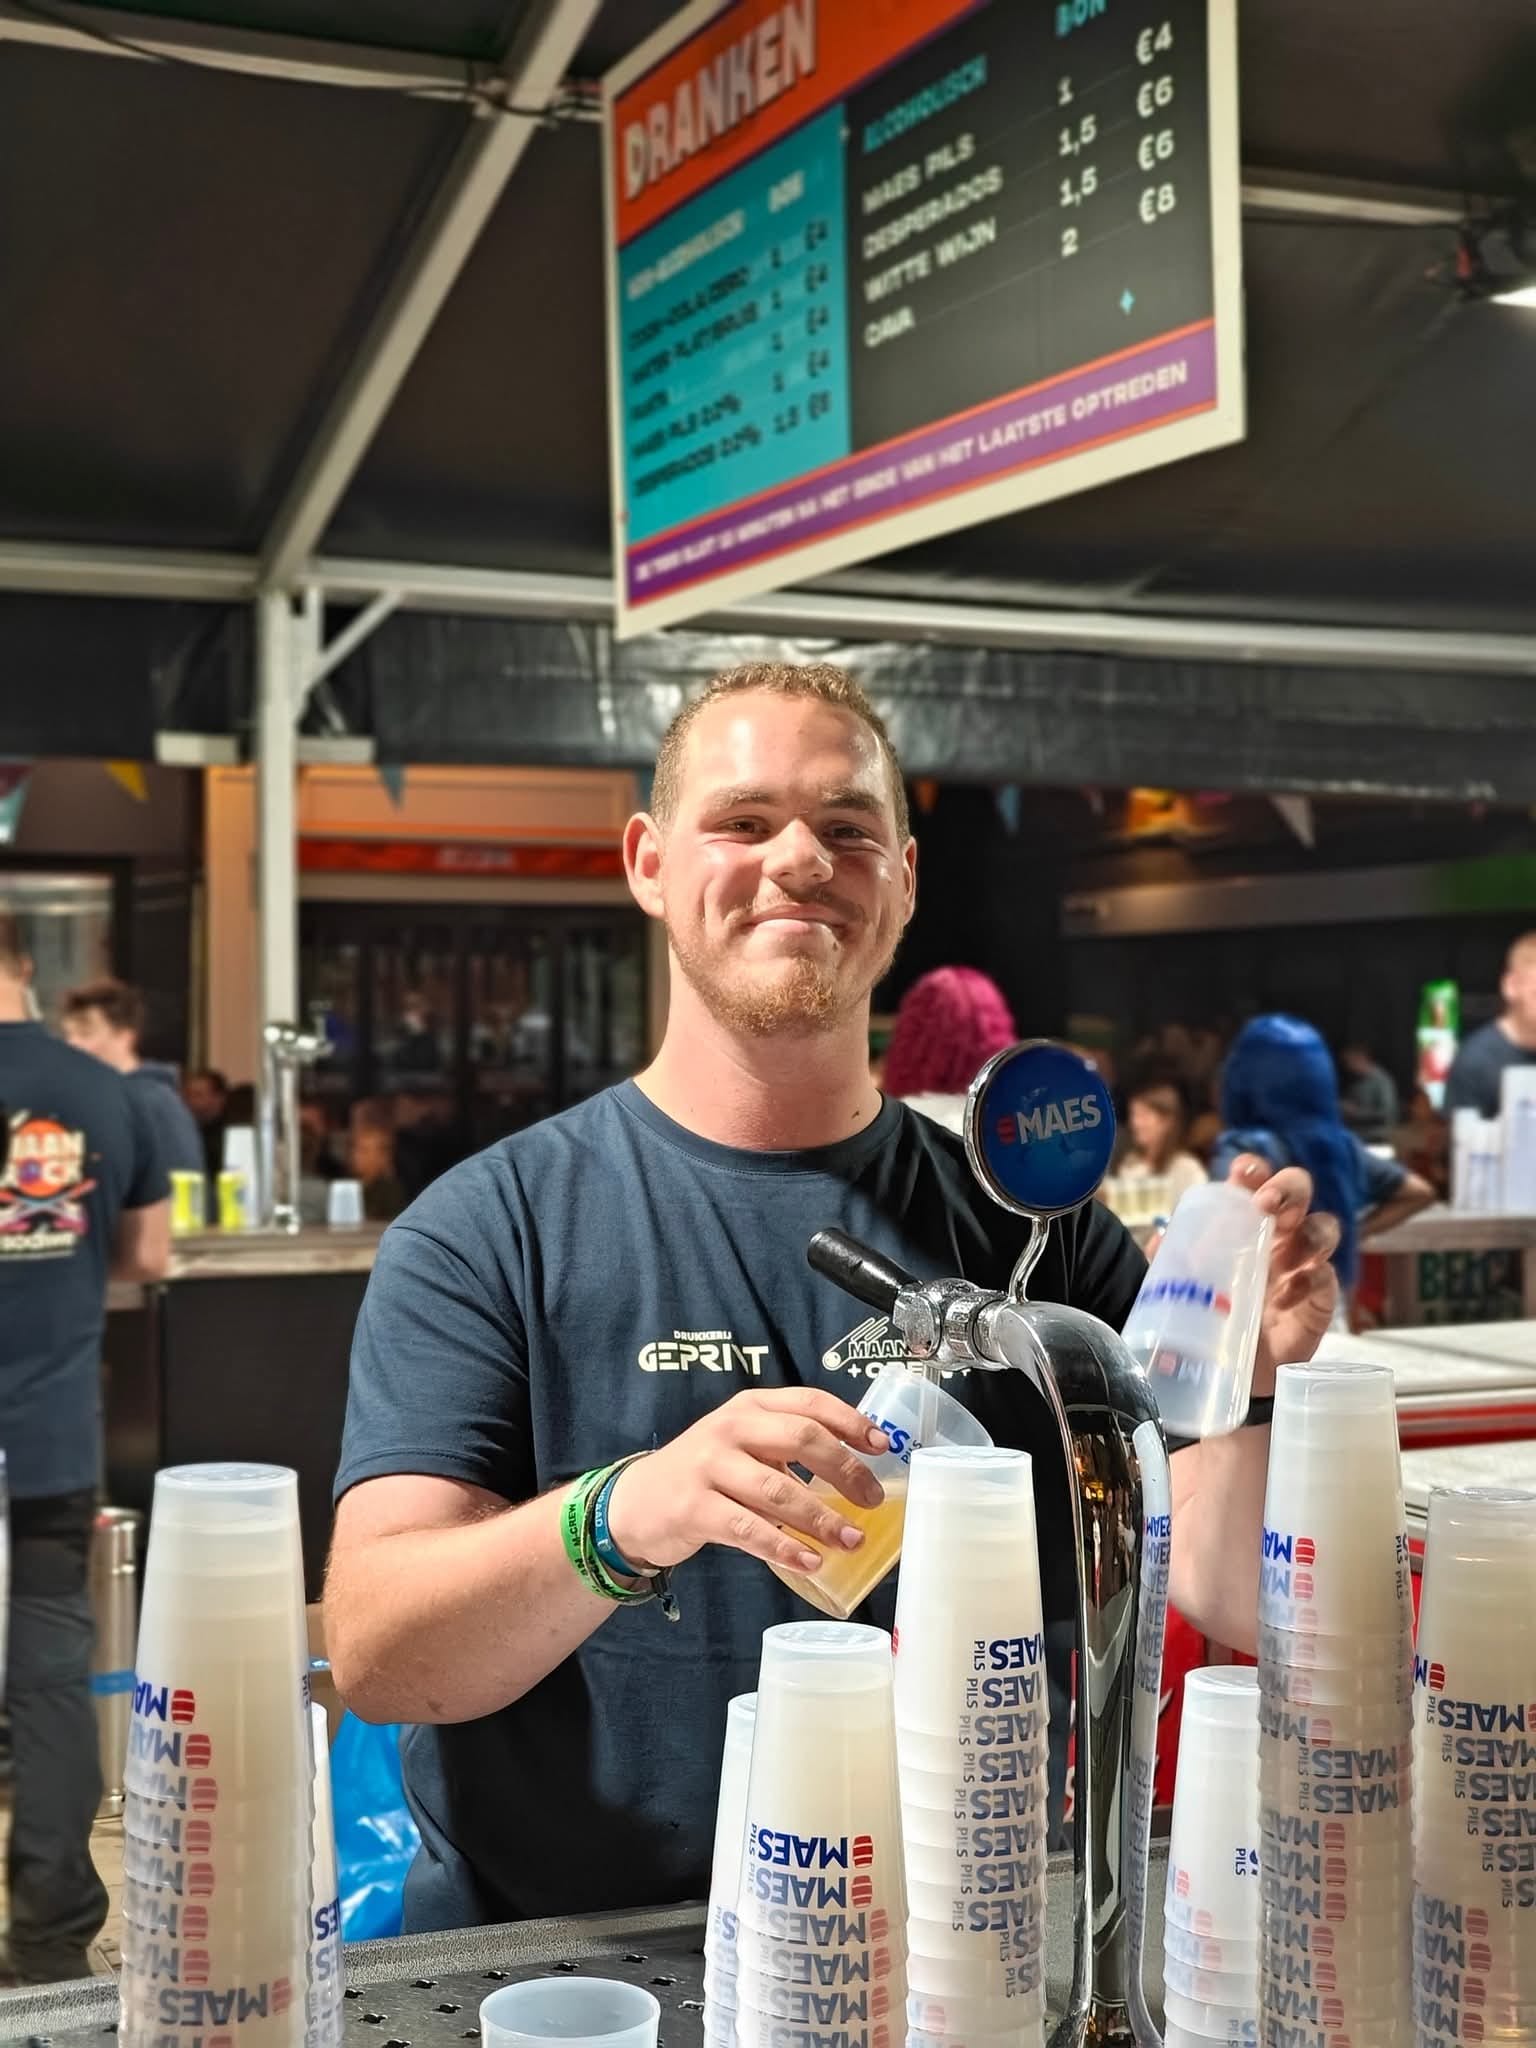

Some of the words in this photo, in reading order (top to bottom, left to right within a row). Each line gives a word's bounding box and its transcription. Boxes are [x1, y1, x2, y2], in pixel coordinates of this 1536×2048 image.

[624, 0, 815, 198] DRANKEN
[863, 165, 920, 214] MAES
[925, 133, 974, 179] PILS
[1059, 77, 1073, 105] 1
[1136, 22, 1171, 64] €4
[863, 166, 1002, 259] DESPERADOS
[1059, 115, 1096, 155] 1,5
[1137, 76, 1172, 117] €6
[864, 252, 931, 302] WITTE
[935, 217, 996, 266] WIJN
[1060, 167, 1097, 206] 1,5
[1138, 130, 1173, 170] €6
[864, 307, 914, 347] CAVA
[1061, 228, 1078, 256] 2
[1139, 184, 1175, 223] €8
[979, 404, 1067, 455] LAATSTE
[1072, 360, 1188, 421] OPTREDEN
[1017, 1095, 1101, 1145] MAES
[673, 1330, 732, 1341] DRUKKERIJ
[848, 1339, 911, 1359] MAAN
[1262, 1528, 1292, 1564] MA
[974, 1640, 985, 1671] PILS
[132, 1682, 169, 1722] MA
[967, 1678, 978, 1708] PILS
[959, 1715, 971, 1745] PILS
[1426, 1695, 1436, 1723] PILS
[1438, 1699, 1525, 1732] MAES
[1312, 1746, 1398, 1779] MAES
[1442, 1734, 1452, 1762] PILS
[964, 1752, 975, 1783] PILS
[1313, 1781, 1399, 1814] MAES
[1455, 1770, 1466, 1799] PILS
[1469, 1773, 1536, 1802] AES
[954, 1789, 966, 1820] PILS
[1467, 1806, 1479, 1836] PILS
[1482, 1807, 1536, 1837] AES
[758, 1829, 848, 1869] MAES
[957, 1827, 968, 1857] PILS
[1482, 1843, 1493, 1872] PILS
[1497, 1842, 1536, 1872] ES
[961, 1864, 972, 1895] PILS
[1235, 1848, 1246, 1876] PILS
[755, 1867, 847, 1909] MAES
[1502, 1879, 1513, 1908] PILS
[768, 1909, 866, 1946] MAES
[953, 1901, 964, 1931] PILS
[1422, 1897, 1461, 1933] MA
[1423, 1930, 1465, 1968] MA
[771, 1949, 870, 1986] MAES
[1006, 1967, 1016, 1998] PILS
[1421, 1966, 1459, 2002] MA
[159, 1982, 268, 2027] MAES
[769, 1987, 868, 2025] MAES
[1420, 2001, 1457, 2037] MA
